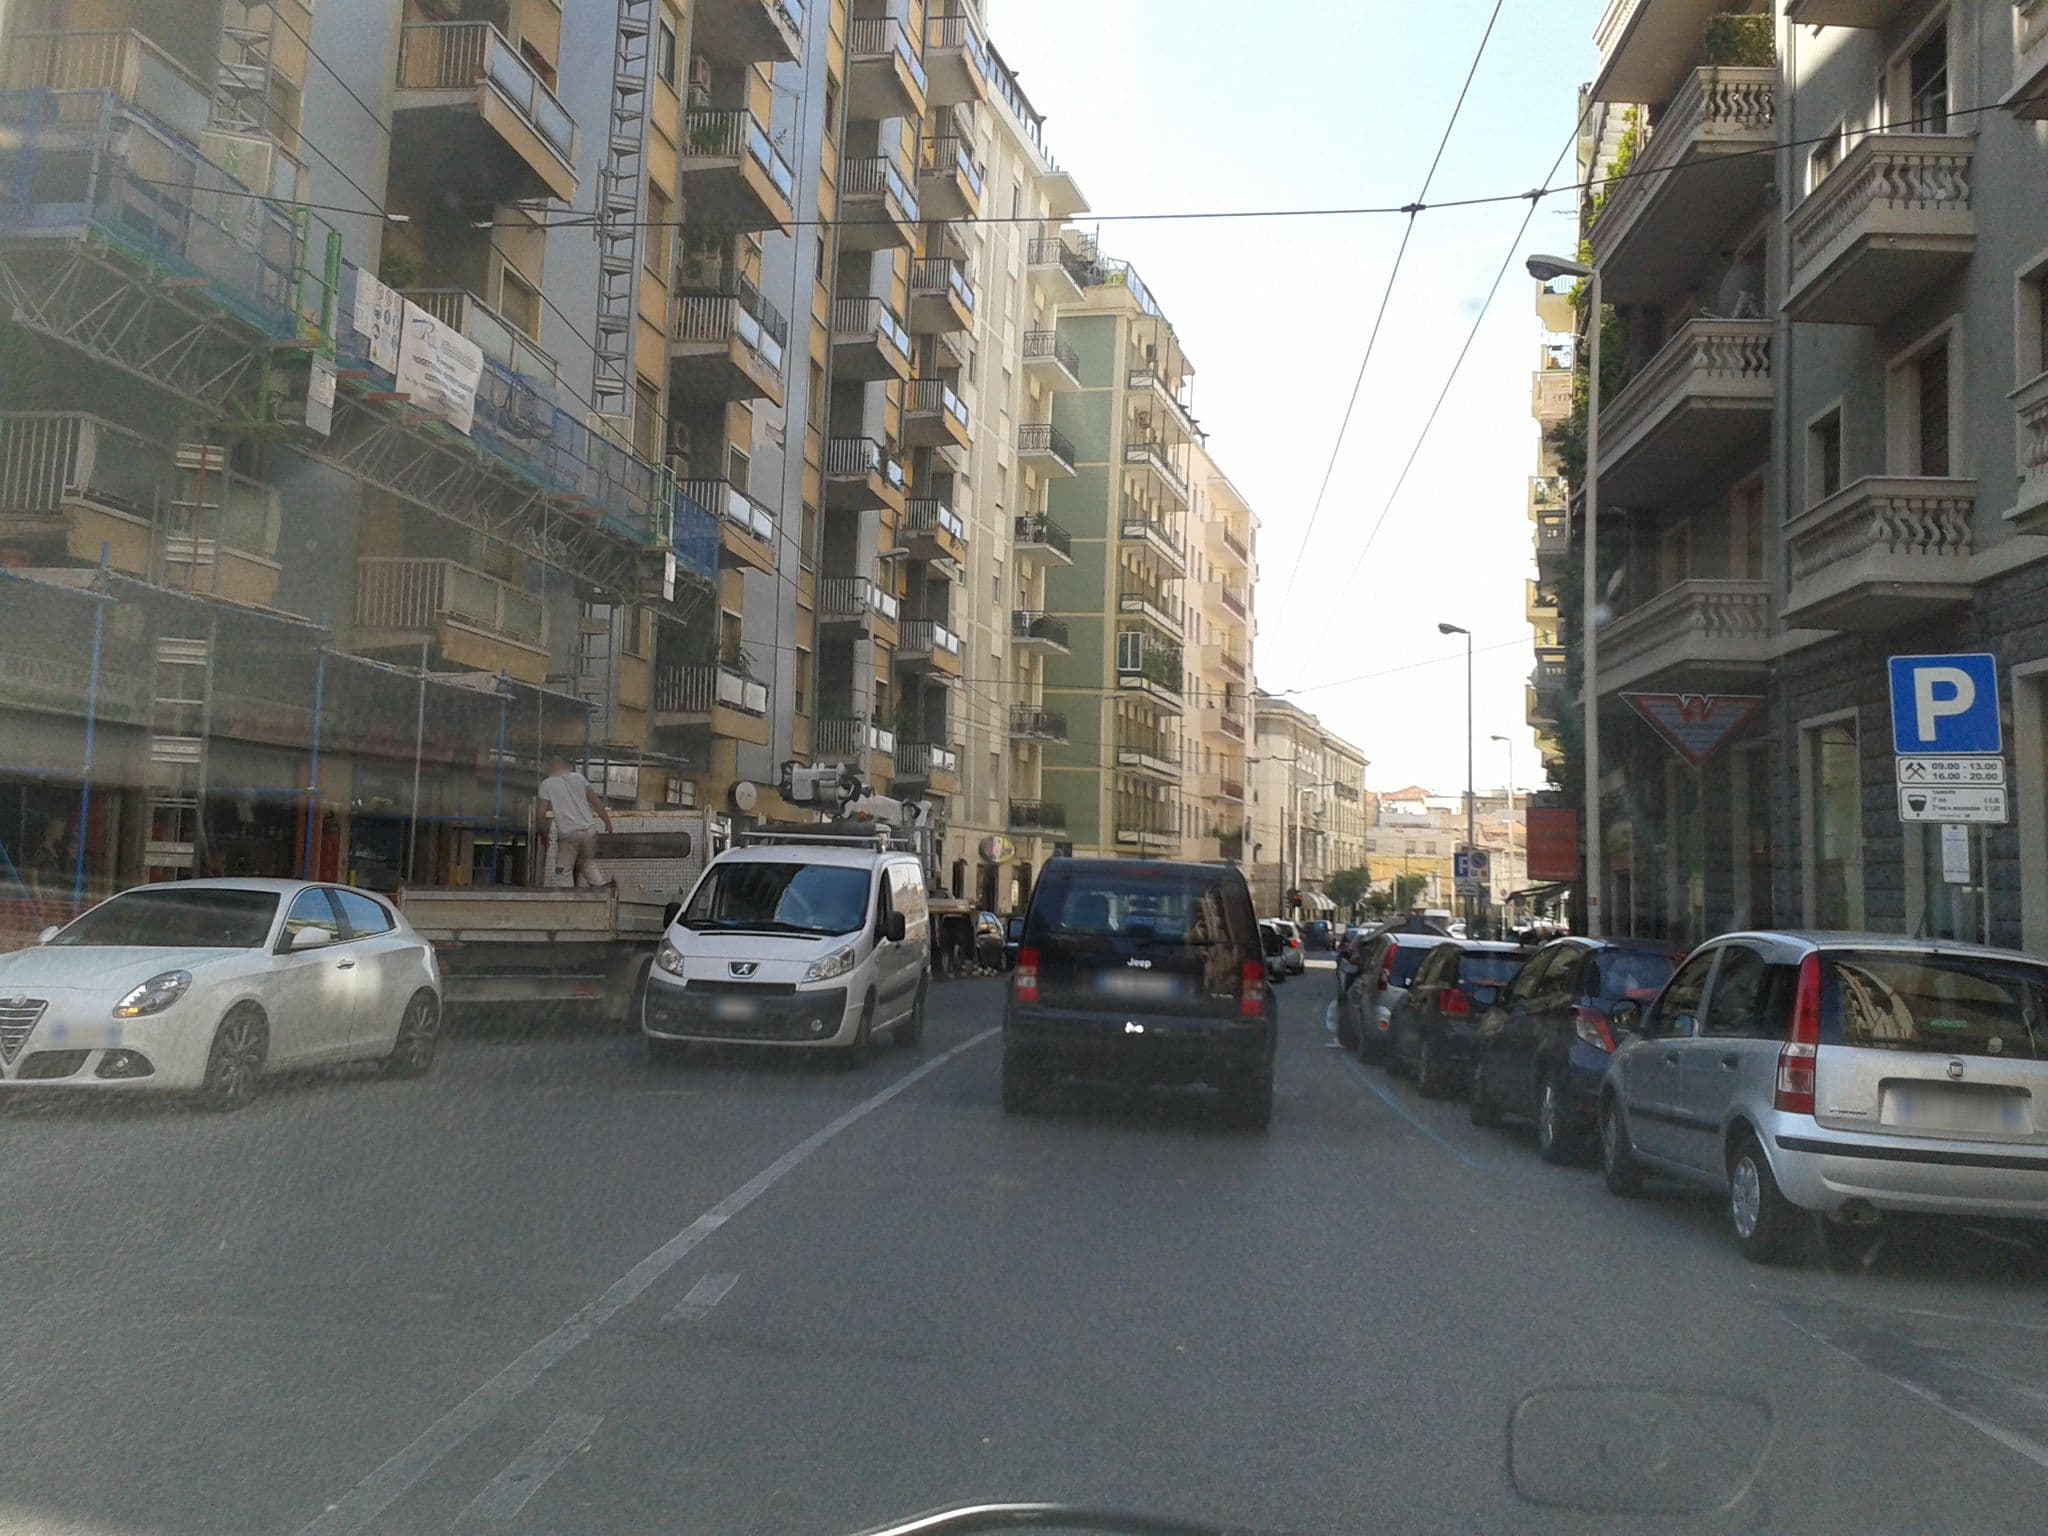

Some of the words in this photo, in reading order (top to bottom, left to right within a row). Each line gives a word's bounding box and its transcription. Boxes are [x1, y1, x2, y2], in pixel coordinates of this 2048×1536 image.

[1913, 667, 1975, 741] P
[1931, 762, 1960, 770] 09.00
[1970, 762, 1998, 770] 13.00
[1969, 772, 1998, 780] 20.00
[1126, 956, 1152, 969] Jeep
